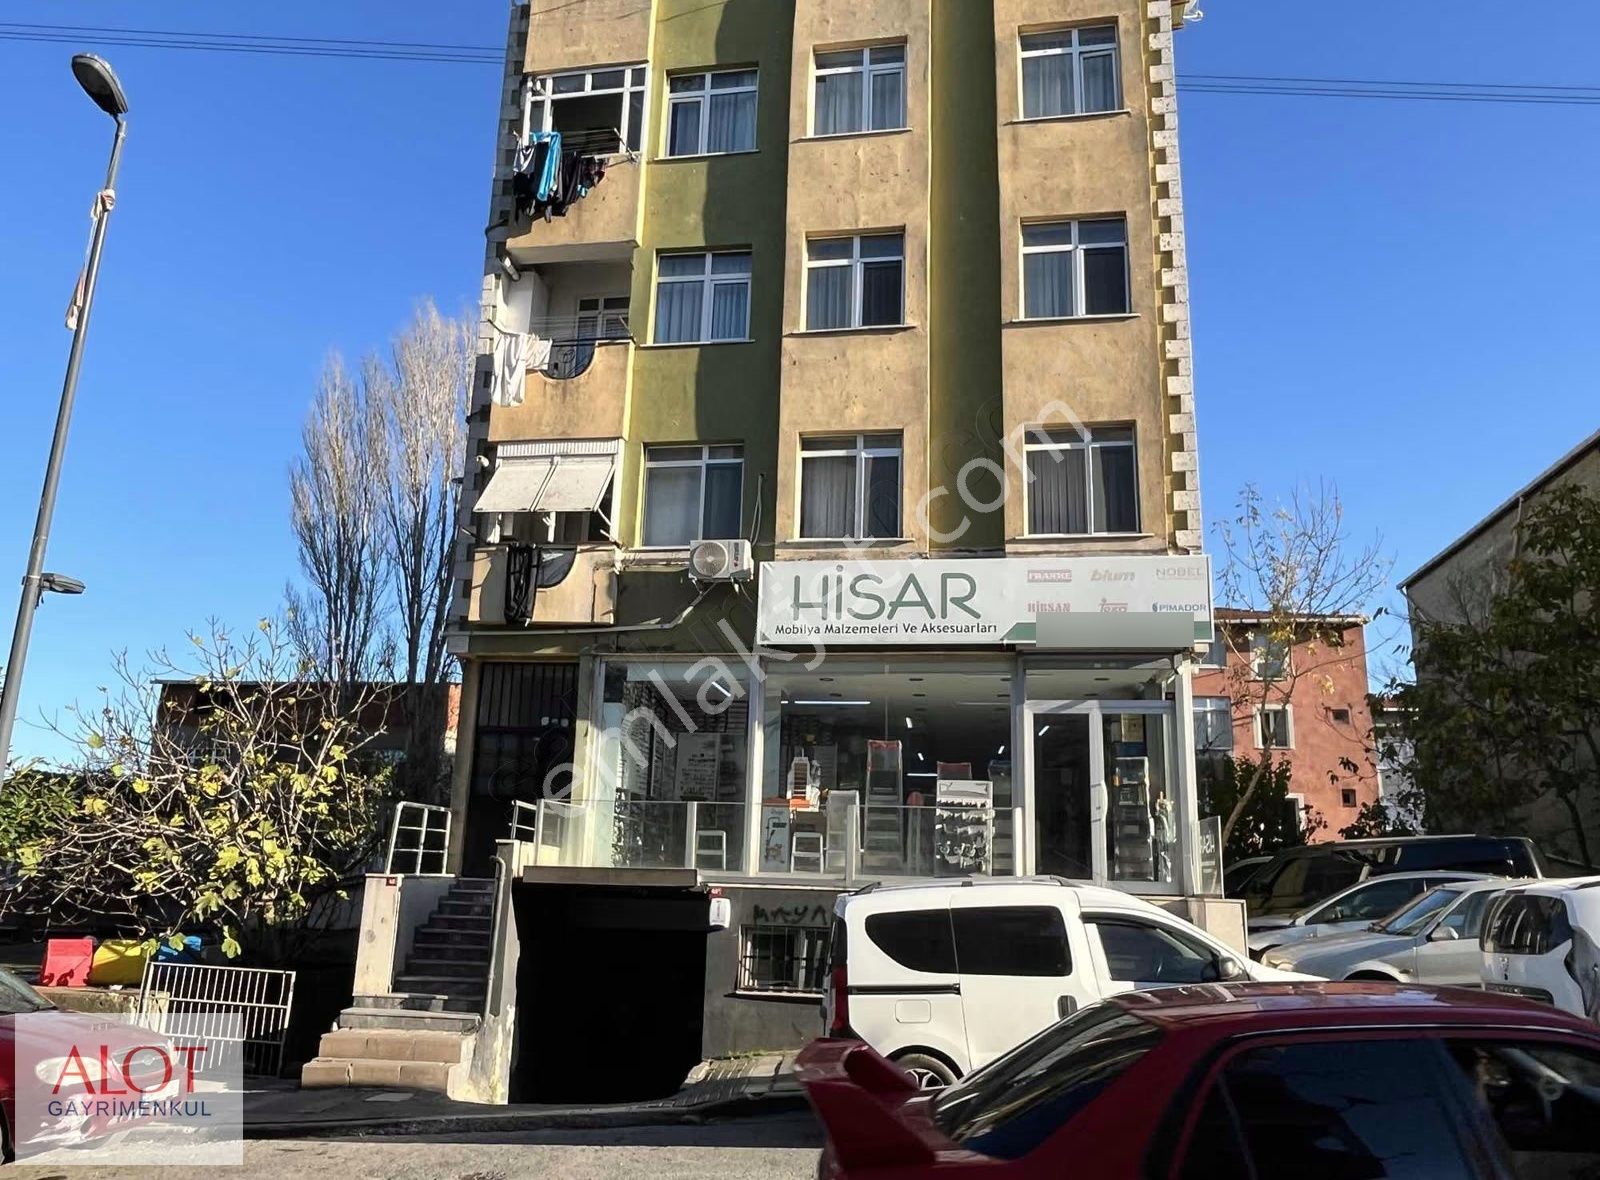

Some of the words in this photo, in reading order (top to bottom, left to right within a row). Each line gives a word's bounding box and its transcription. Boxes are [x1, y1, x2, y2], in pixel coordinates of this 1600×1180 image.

[1155, 567, 1205, 577] NOBEL
[791, 564, 981, 620] HİSAR
[775, 624, 821, 636] Mobilya
[824, 623, 899, 635] Malzemeleri
[903, 622, 918, 634] Ve
[920, 622, 997, 634] Aksesuarları
